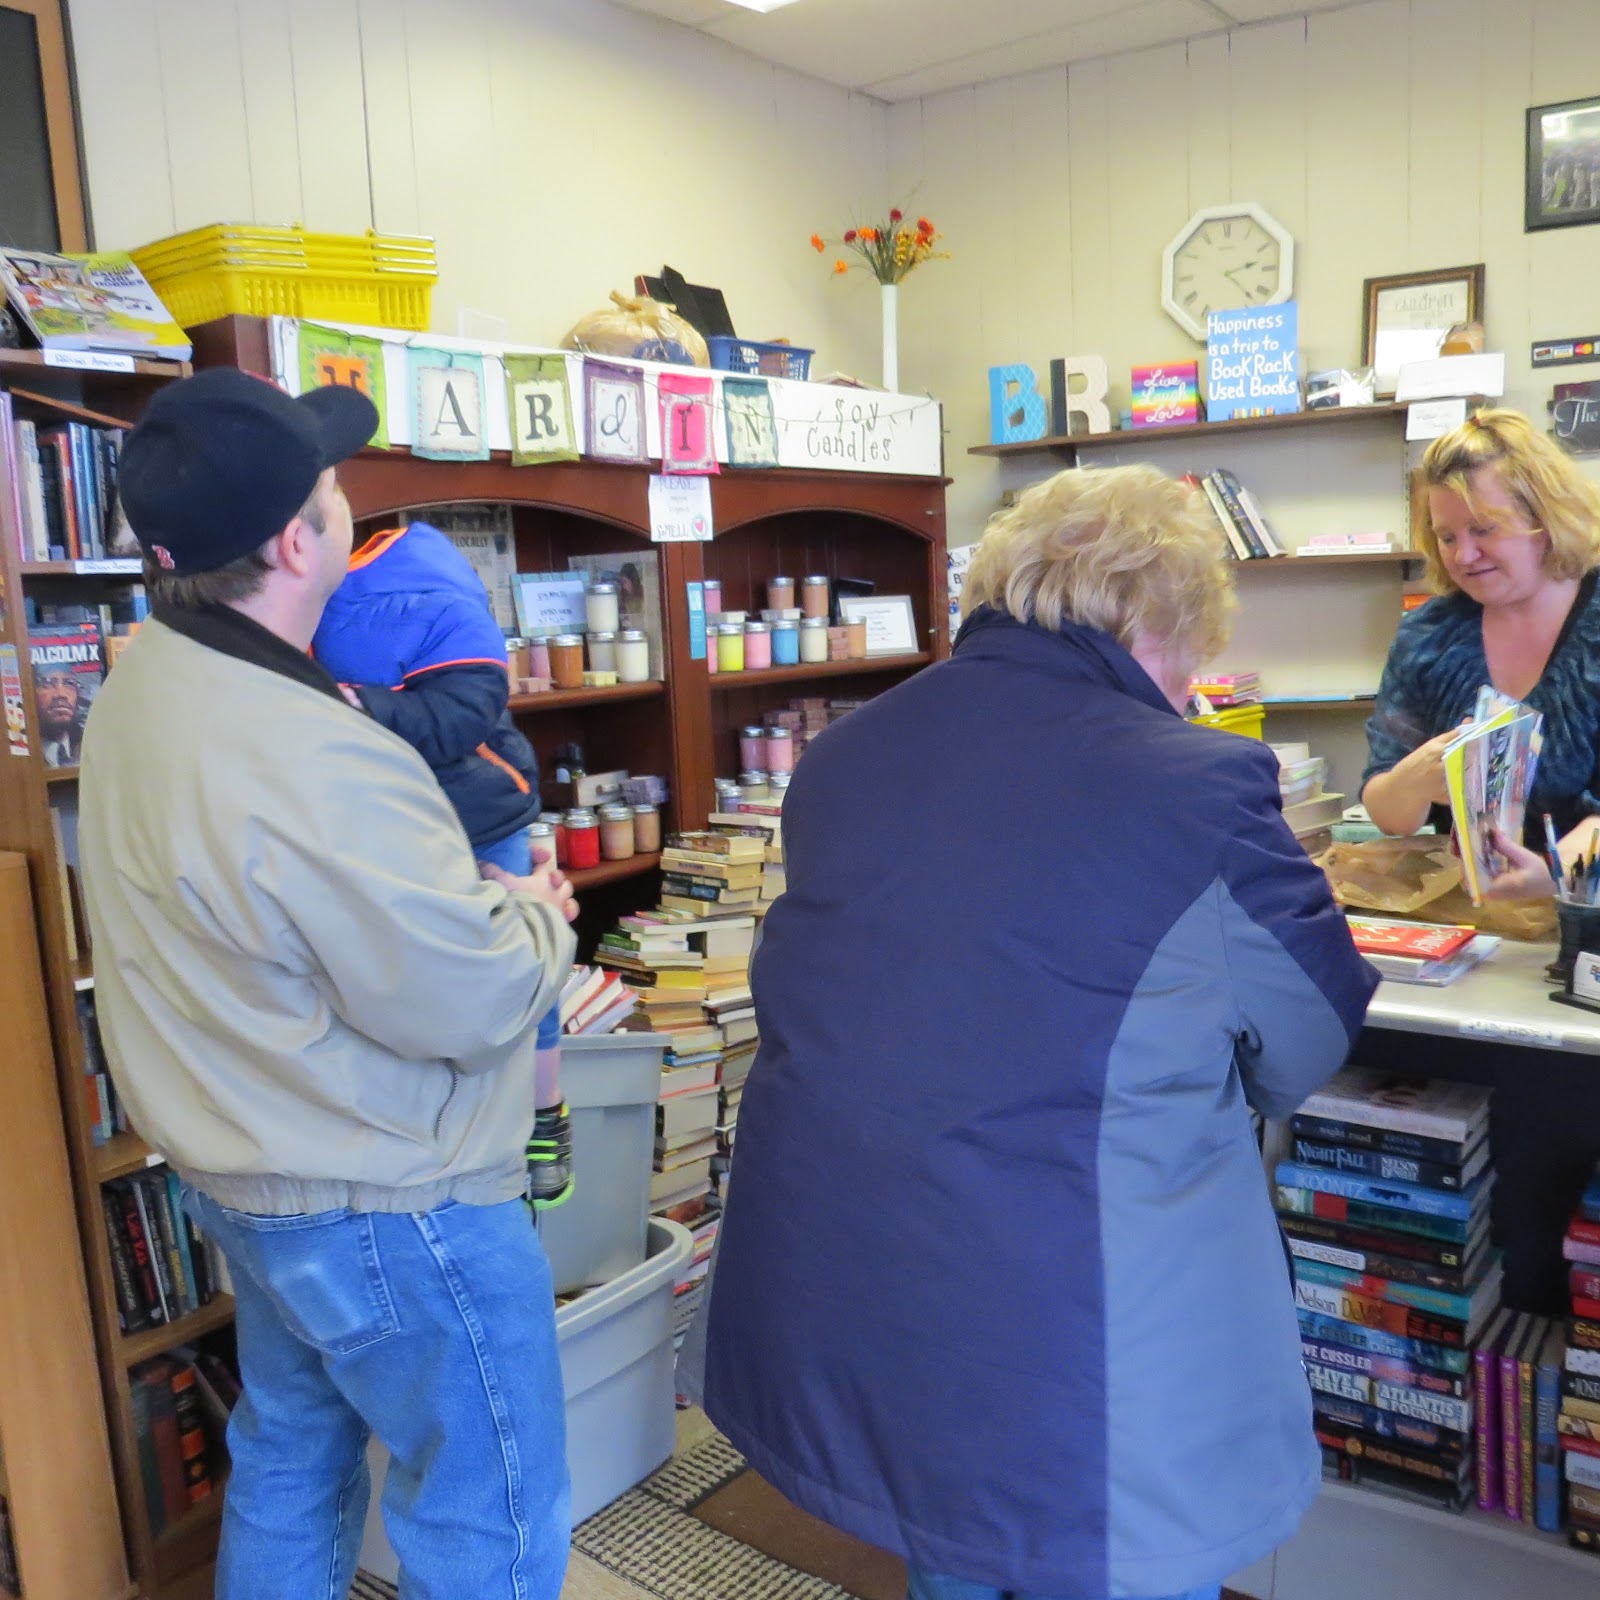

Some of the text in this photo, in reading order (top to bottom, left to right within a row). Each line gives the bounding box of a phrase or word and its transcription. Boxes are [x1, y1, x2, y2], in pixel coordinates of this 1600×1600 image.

[1206, 313, 1283, 336] Happiness
[1209, 334, 1279, 357] is a trip to
[1143, 369, 1181, 387] Live
[1208, 379, 1246, 400] Used
[1137, 382, 1187, 411] Laugh
[1145, 406, 1185, 422] Love
[807, 424, 891, 462] Candles
[31, 643, 101, 665] ALCOLM X
[1297, 1285, 1337, 1314] Nelson
[1320, 1347, 1372, 1370] CUSSLER
[1311, 1378, 1364, 1402] SSLER
[1379, 1383, 1454, 1418] ATLANTIS
